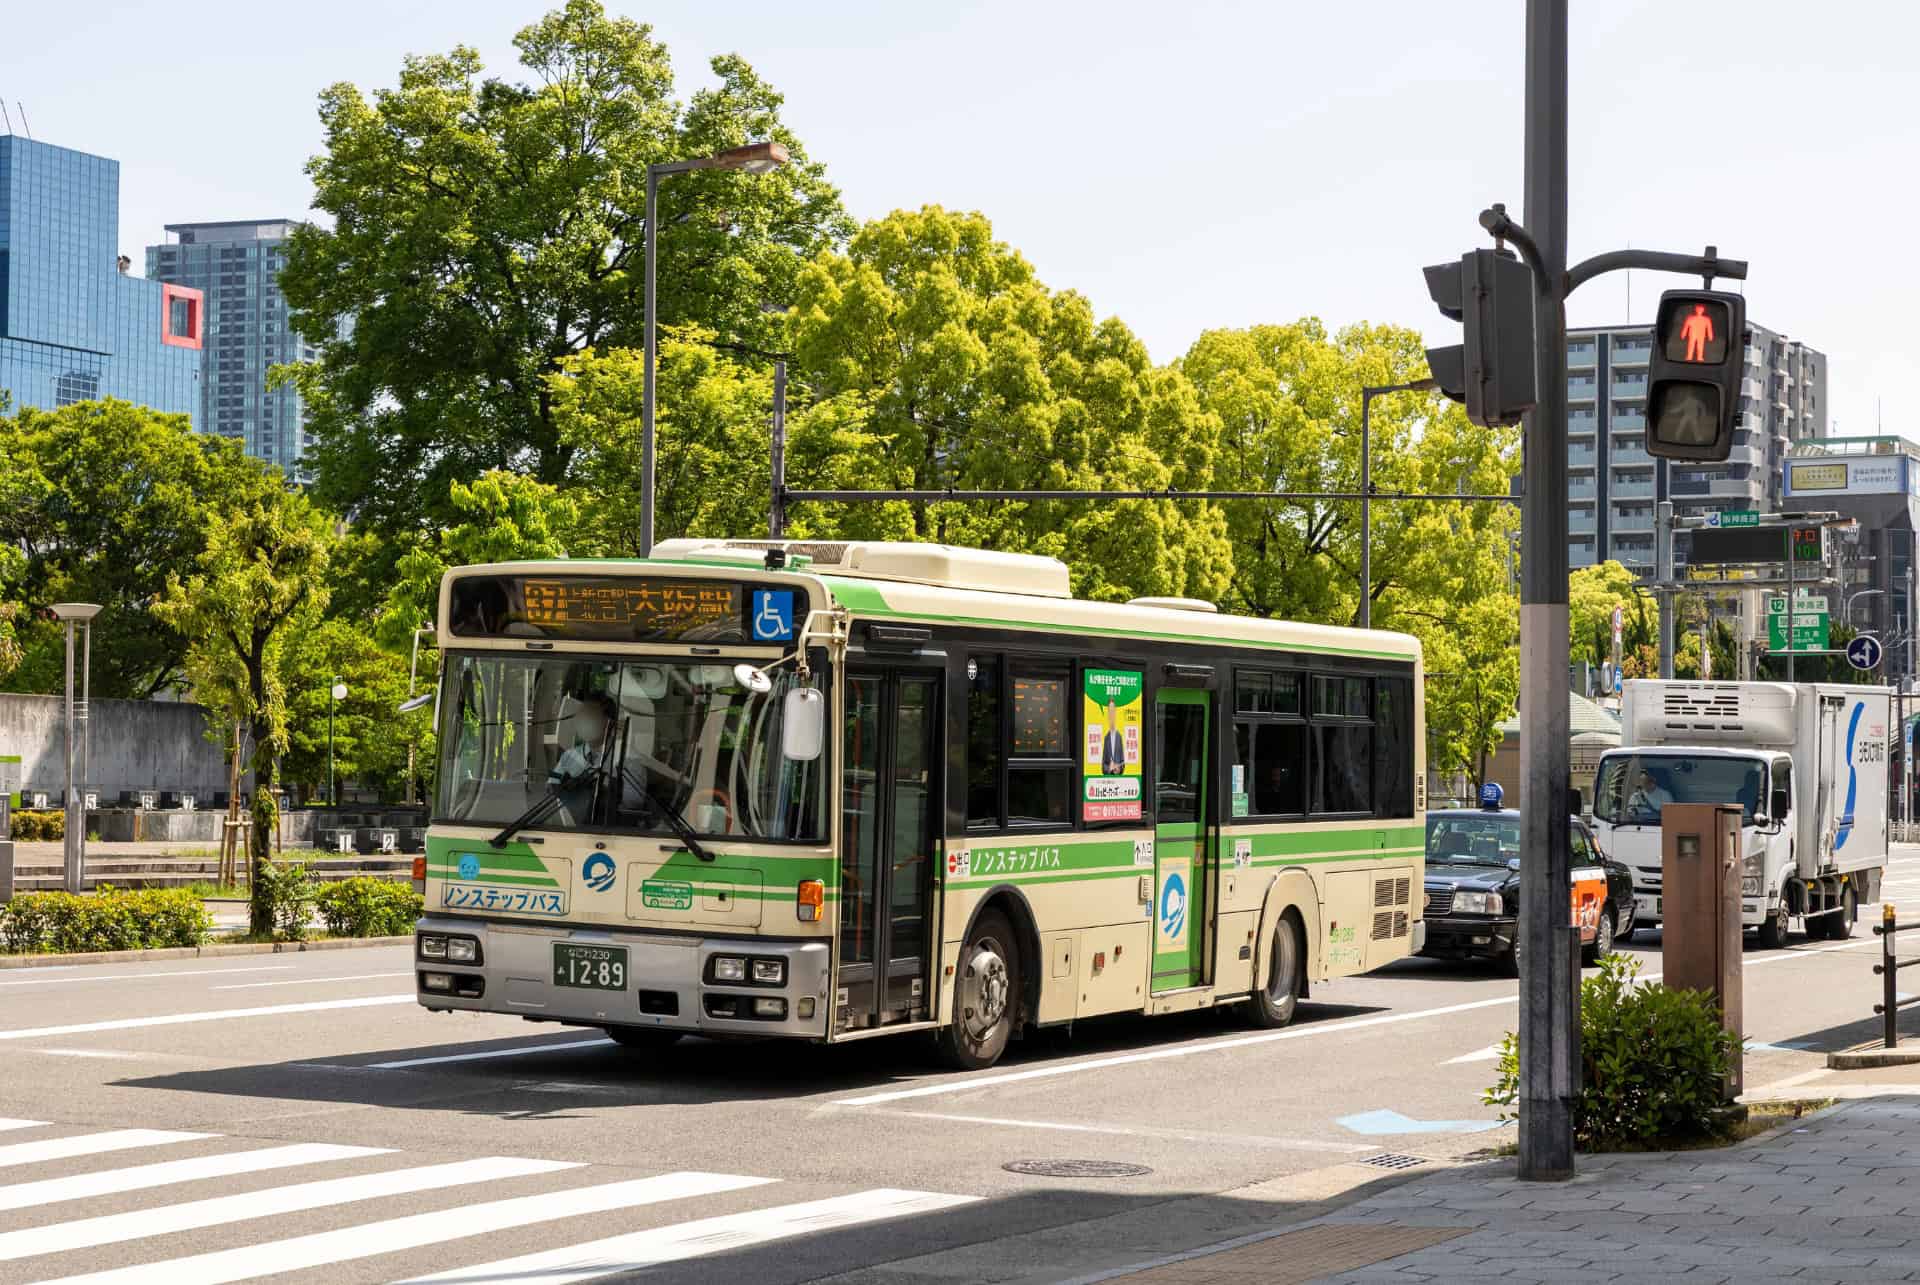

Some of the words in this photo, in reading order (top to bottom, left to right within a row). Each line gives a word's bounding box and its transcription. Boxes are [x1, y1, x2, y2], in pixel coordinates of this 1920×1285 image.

[974, 847, 1061, 873] ノンステップバス
[444, 887, 562, 912] ノンステップバス
[569, 959, 624, 987] 12-89
